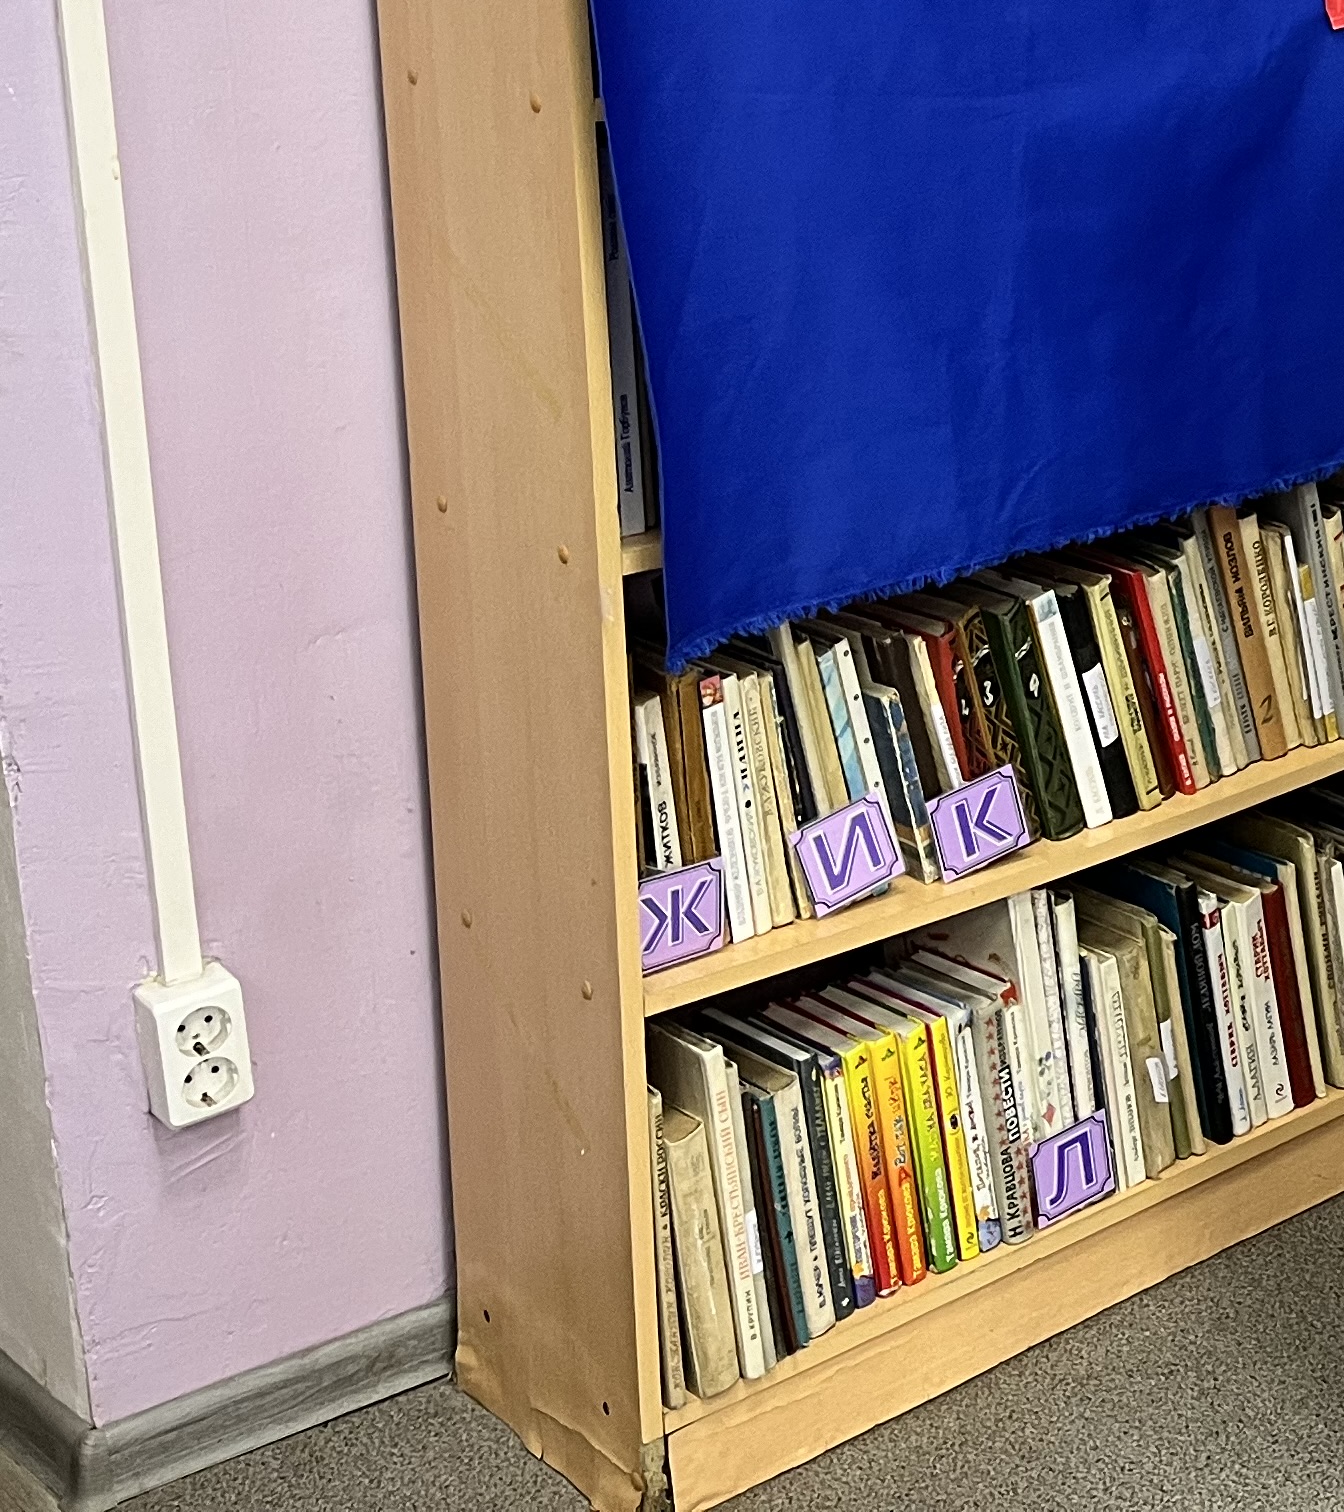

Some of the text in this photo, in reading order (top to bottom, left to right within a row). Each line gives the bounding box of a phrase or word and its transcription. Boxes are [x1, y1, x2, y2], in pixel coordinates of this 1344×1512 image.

[1250, 539, 1275, 616] КОРОЛЕНКО
[983, 680, 993, 705] 3
[656, 800, 676, 867] ЖИТКОВ
[953, 785, 1014, 863] К
[811, 810, 884, 894] И
[640, 879, 711, 955] Ж
[1251, 932, 1263, 978] СТАРИК
[713, 1089, 729, 1124] СЫН
[999, 1067, 1019, 1141] ПОВЕСТИ
[932, 1167, 950, 1218] Крюкова
[1045, 1131, 1094, 1208] Л
[718, 1125, 753, 1281] ИВАН-КРЕСТЬЯНСКИЙ
[876, 1188, 894, 1241] Крюкова
[900, 1181, 918, 1234] Крюкова
[884, 1240, 900, 1285] Тамара
[907, 1234, 923, 1279] Тамара
[940, 1219, 956, 1262] Тамара
